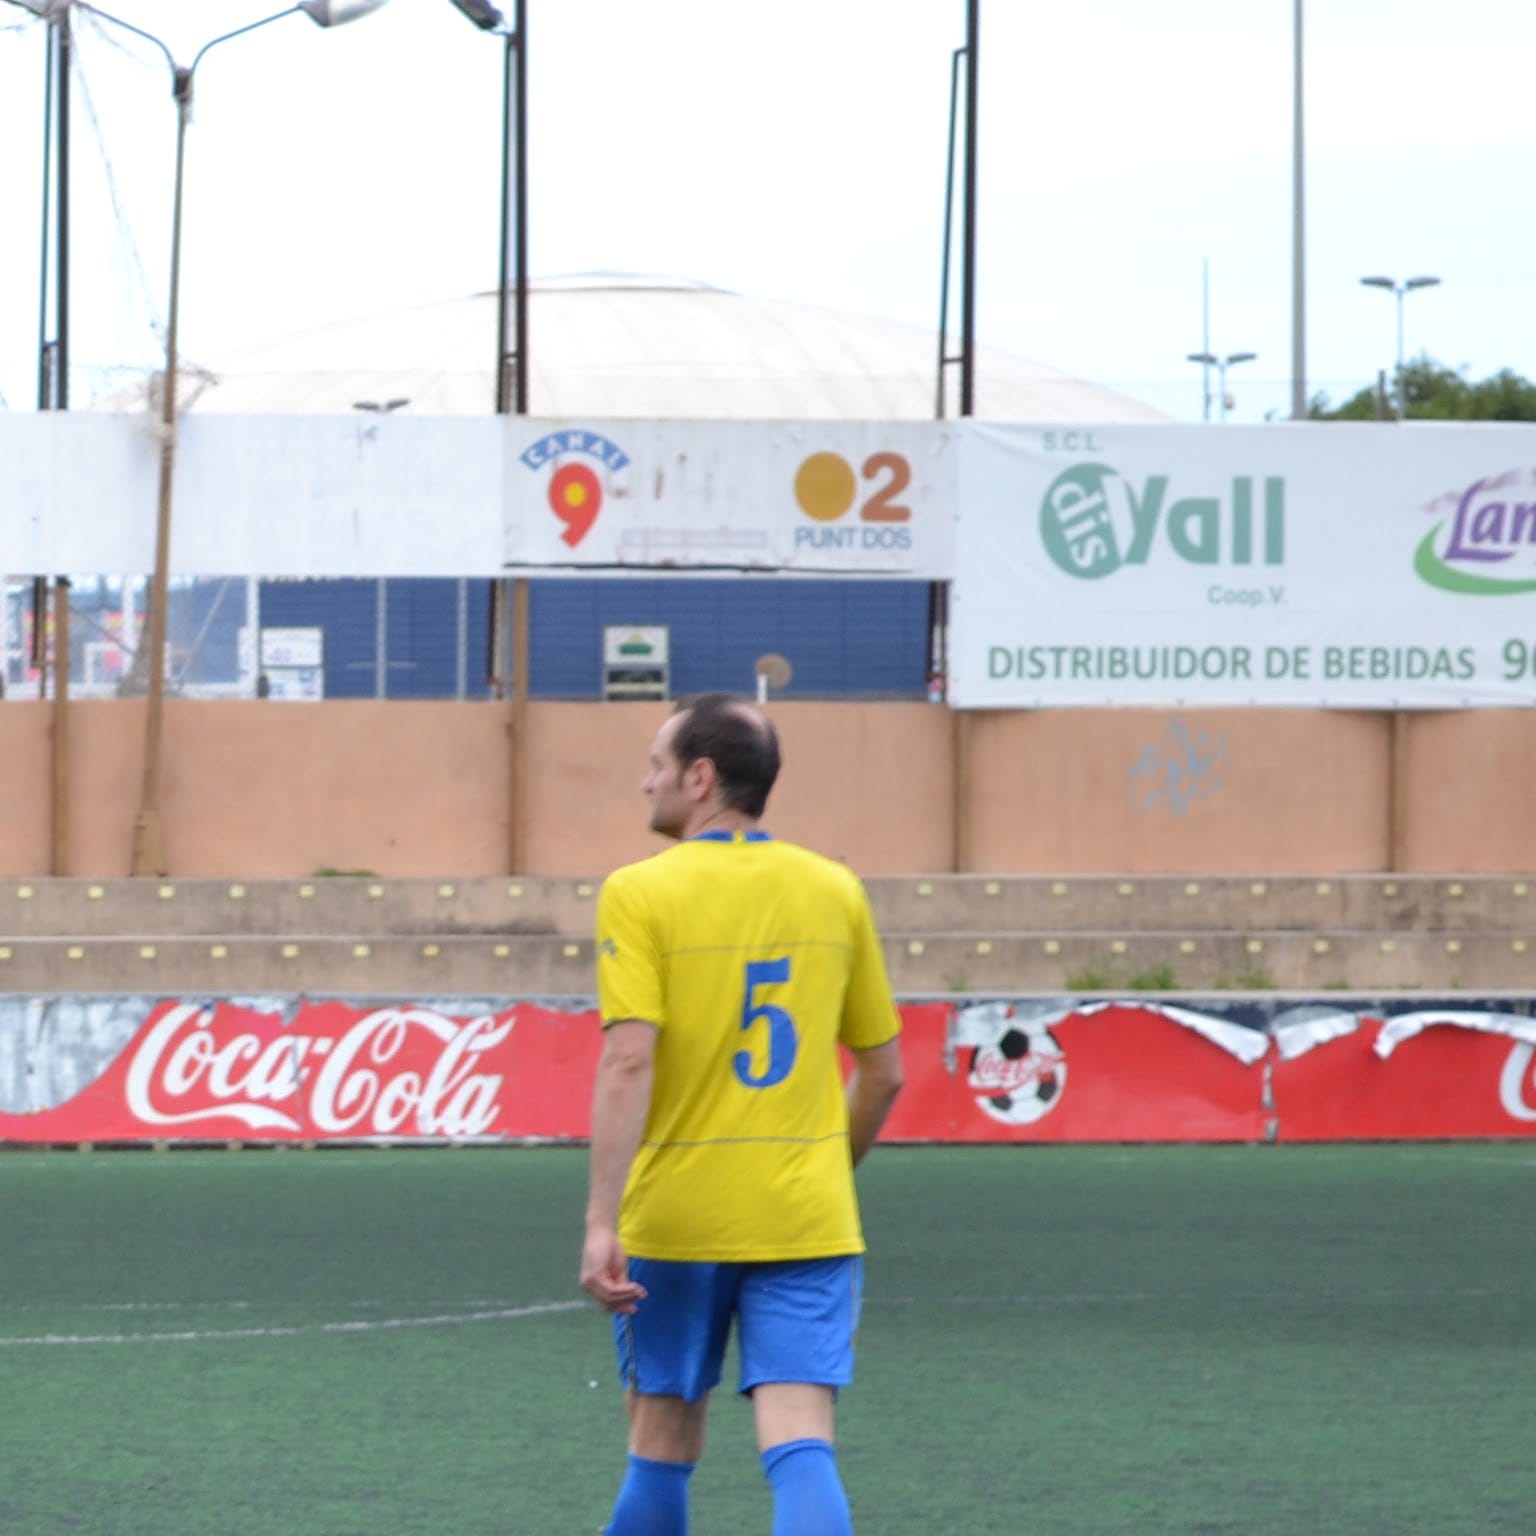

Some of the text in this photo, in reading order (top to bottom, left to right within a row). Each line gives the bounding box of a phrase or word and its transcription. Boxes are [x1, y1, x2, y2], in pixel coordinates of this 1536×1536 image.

[793, 526, 913, 548] PUNT DOS
[987, 646, 1253, 680] DISTRIBUIDOR
[1265, 646, 1310, 680] DE
[1323, 646, 1476, 680] BEBIDAS
[732, 956, 799, 1090] 5
[125, 1001, 517, 1136] Coca-Cola
